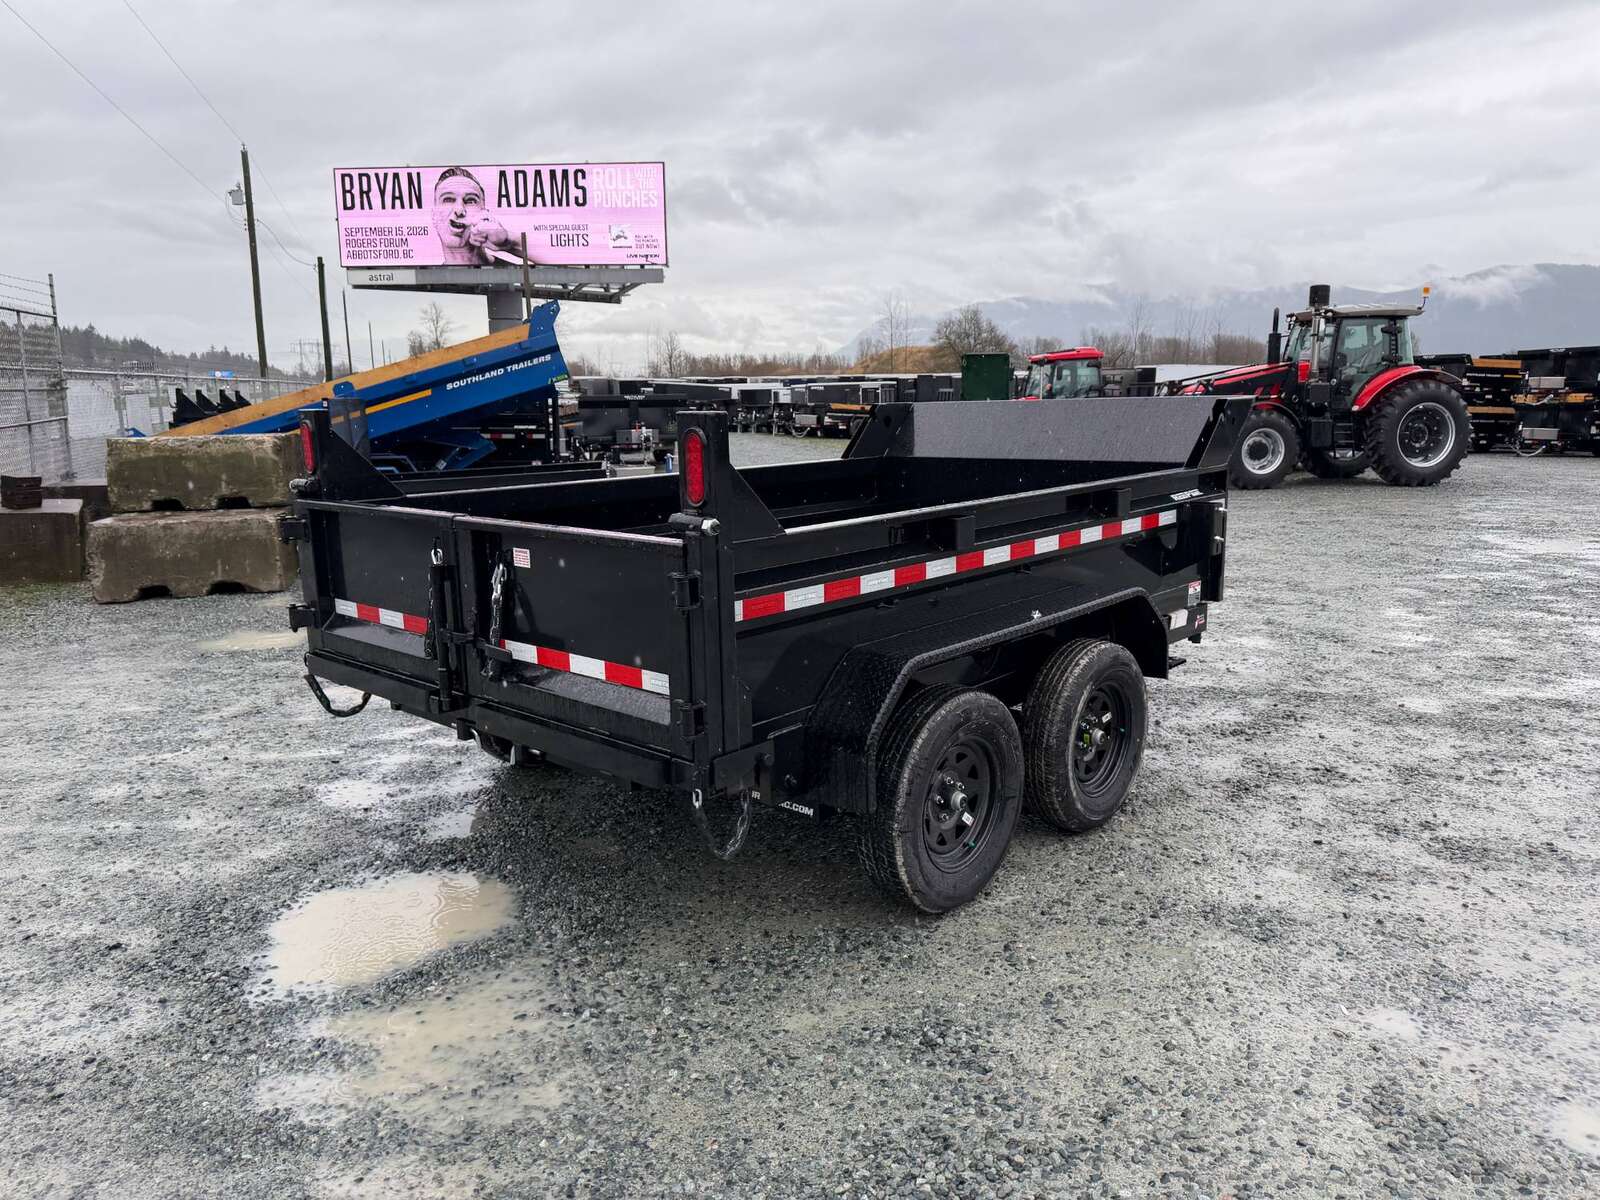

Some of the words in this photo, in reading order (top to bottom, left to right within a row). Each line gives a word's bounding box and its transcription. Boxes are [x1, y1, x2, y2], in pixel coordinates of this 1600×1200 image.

[592, 167, 633, 190] ROLL
[341, 172, 423, 210] BRYAN
[497, 168, 588, 208] ADAMS
[593, 190, 658, 208] PUNCHES
[344, 227, 393, 237] SEPTEMBER
[406, 226, 429, 236] 2026
[345, 238, 378, 248] ROGERS
[379, 238, 409, 248] FORUM
[550, 233, 589, 247] LIGHTS
[402, 249, 414, 259] BC
[368, 273, 394, 282] astral
[446, 368, 504, 390] SOUTHLAND
[506, 354, 552, 372] TRAILERS
